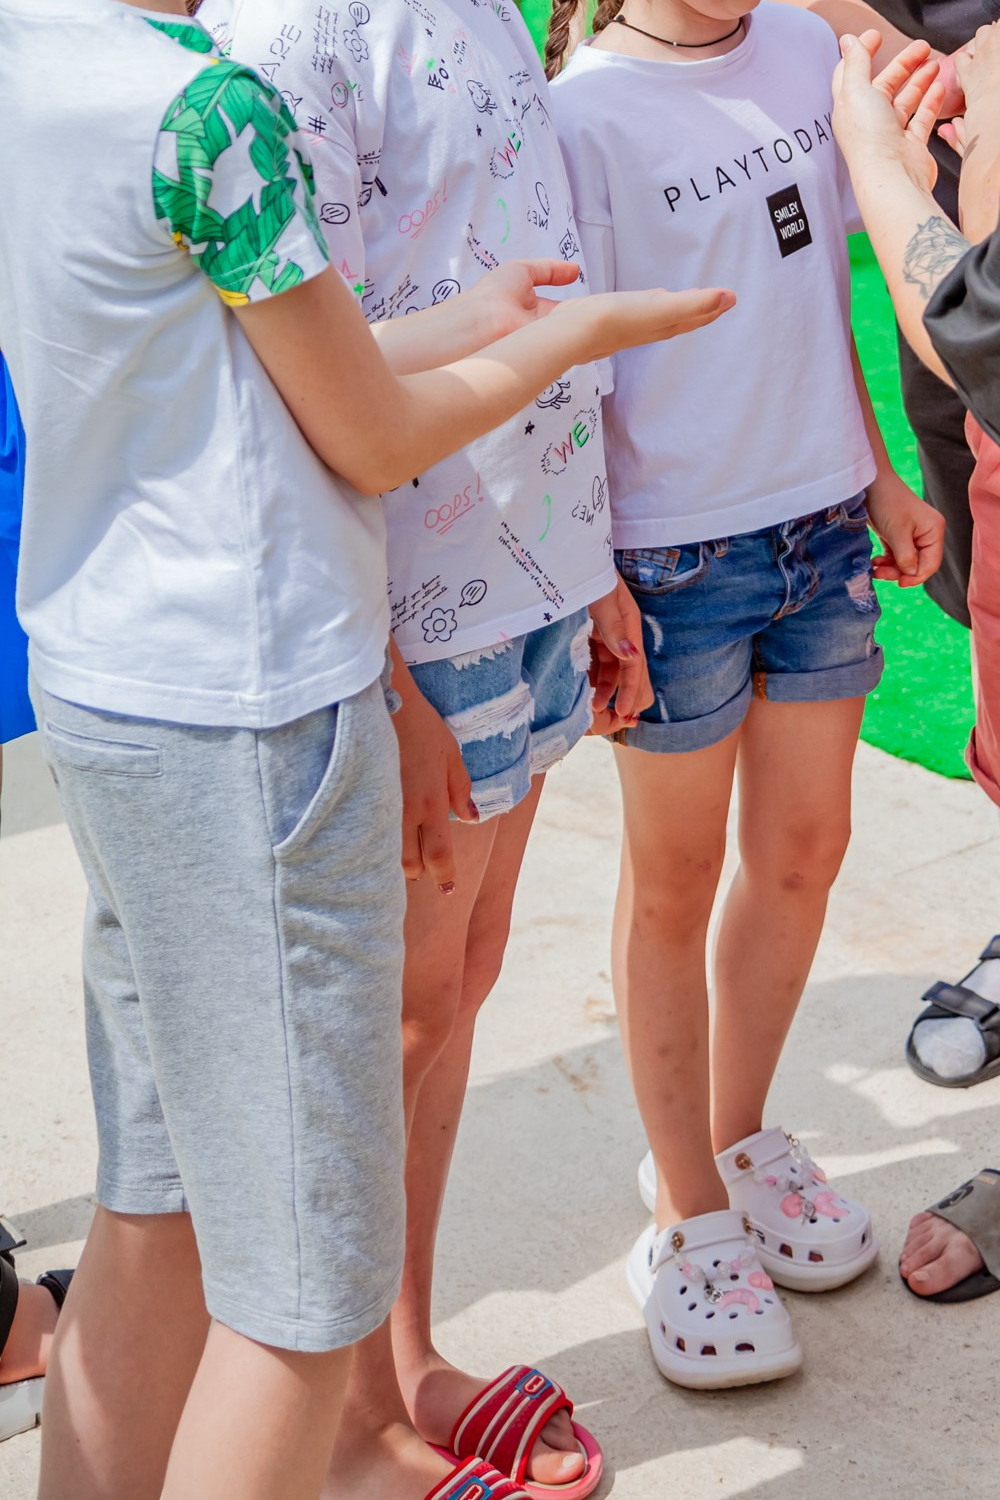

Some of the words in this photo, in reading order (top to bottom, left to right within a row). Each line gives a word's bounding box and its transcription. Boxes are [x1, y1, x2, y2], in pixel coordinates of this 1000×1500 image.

[664, 112, 834, 212] PLAYTODAY
[774, 201, 800, 223] SMILEY
[780, 219, 805, 240] WORLD
[553, 421, 590, 464] WE
[424, 473, 485, 528] OOPS!
